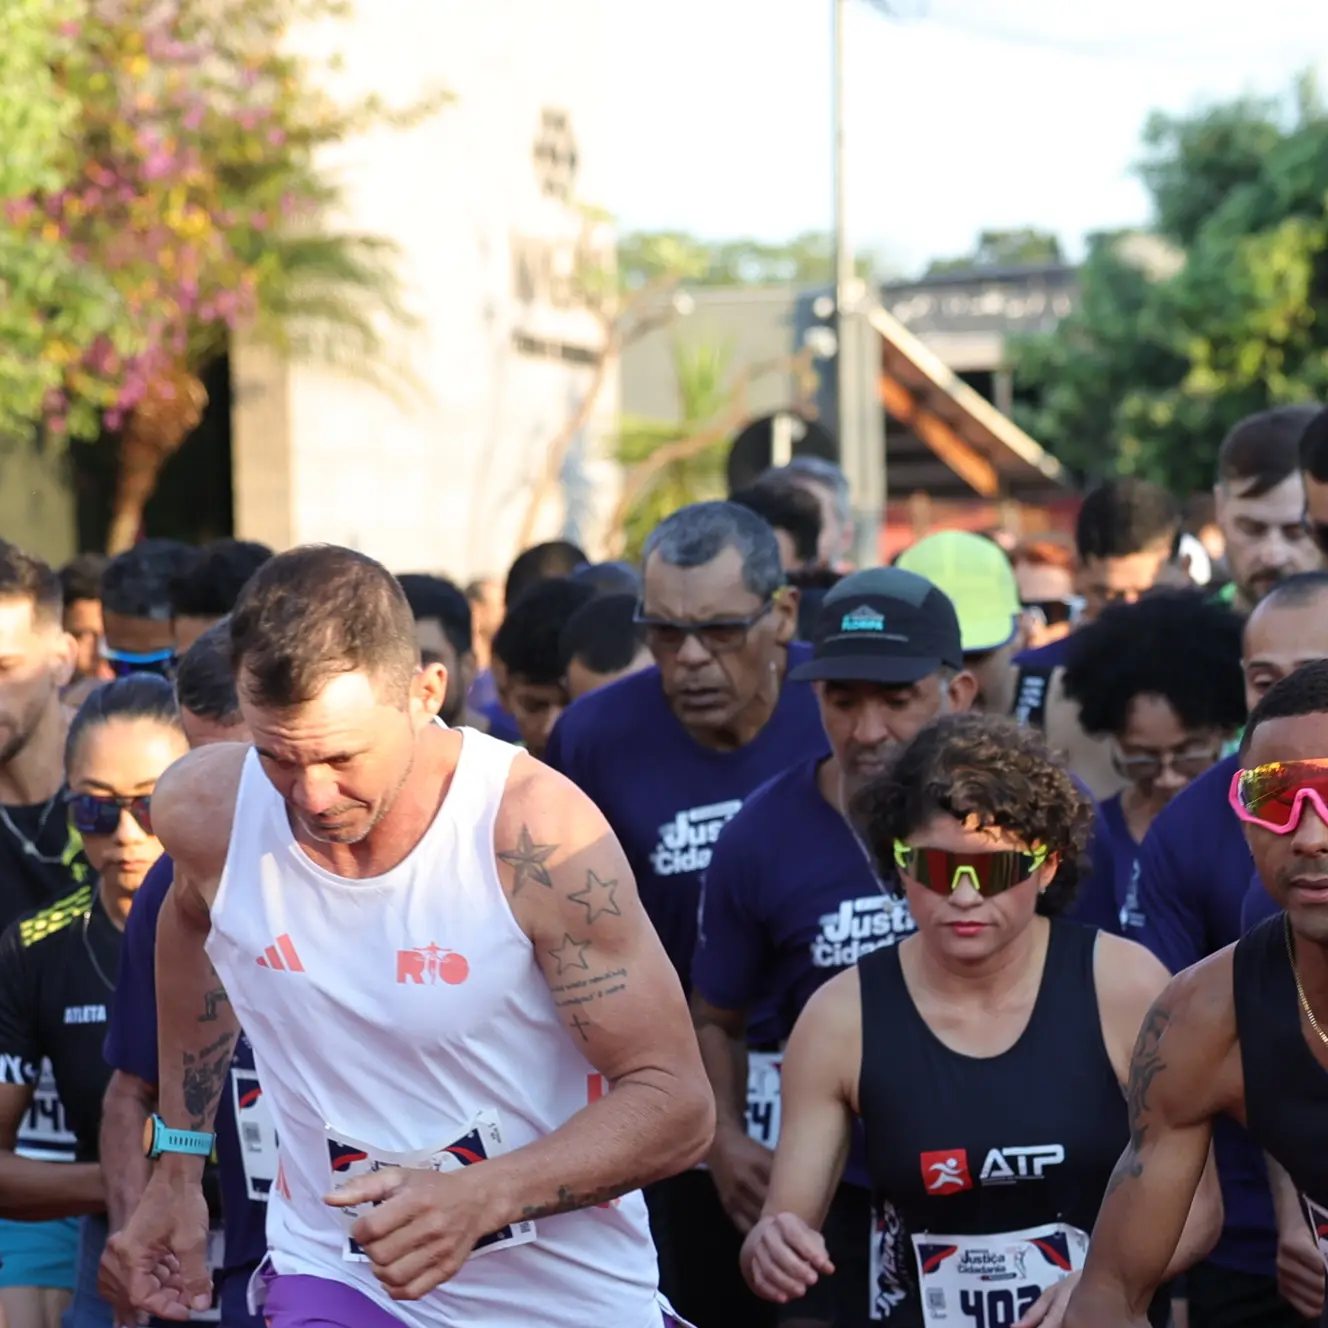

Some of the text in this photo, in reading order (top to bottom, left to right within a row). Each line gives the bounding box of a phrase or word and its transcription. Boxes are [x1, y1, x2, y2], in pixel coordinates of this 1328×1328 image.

[825, 900, 918, 942] Justi
[64, 1005, 107, 1024] ATLETA
[980, 1145, 1065, 1179] ATP
[961, 1250, 1005, 1266] Justiça
[958, 1265, 1006, 1274] Cidadania
